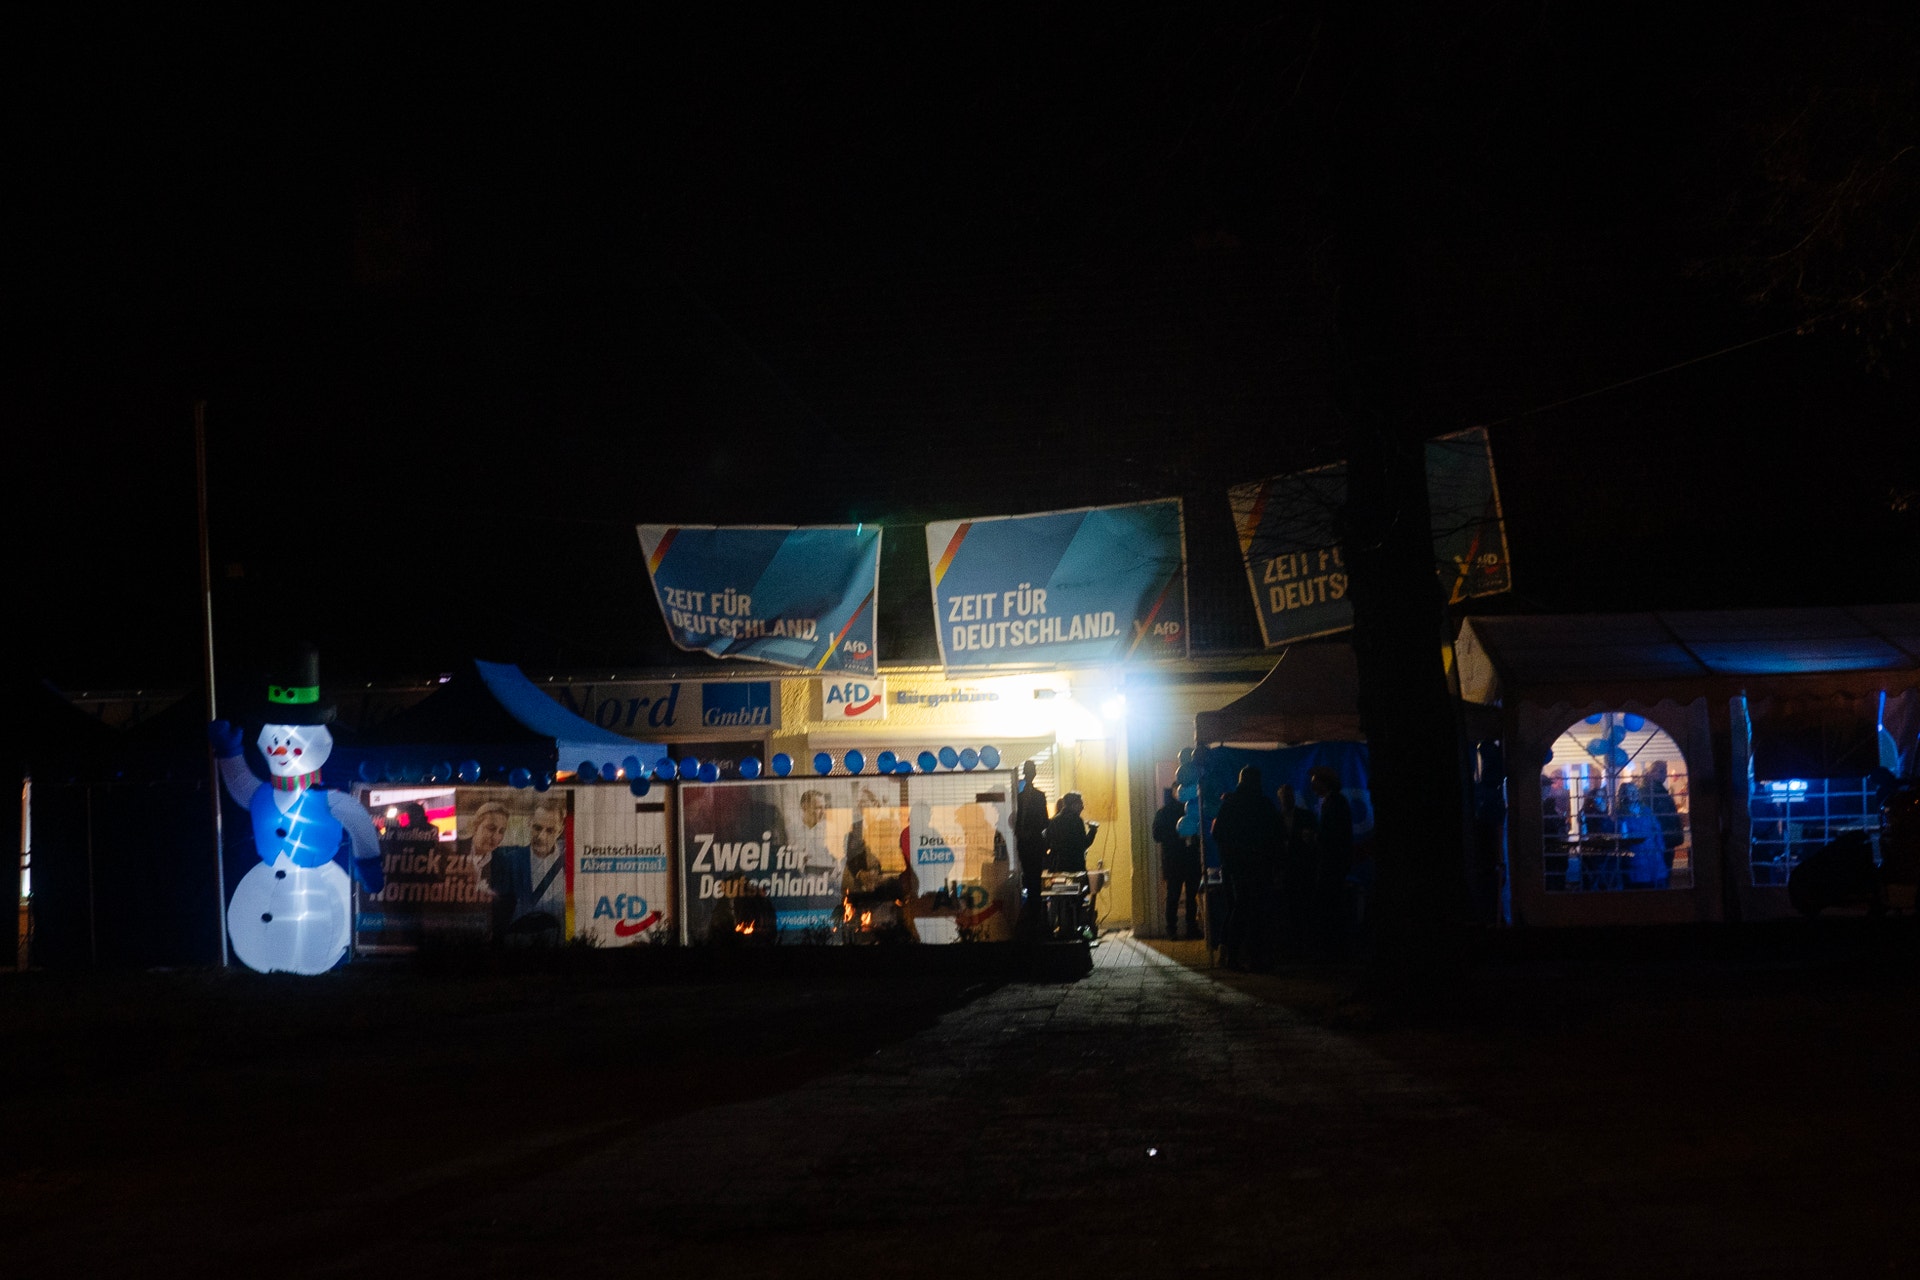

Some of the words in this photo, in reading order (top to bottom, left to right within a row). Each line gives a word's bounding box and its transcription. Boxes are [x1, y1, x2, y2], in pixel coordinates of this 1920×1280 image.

[664, 586, 705, 612] ZEIT
[711, 587, 752, 617] FÜR
[948, 592, 997, 622] ZEIT
[1003, 582, 1048, 618] FÜR
[672, 608, 819, 642] DEUTSCHLAND.
[953, 611, 1121, 651] DEUTSCHLAND.
[1154, 621, 1180, 635] AfD
[843, 640, 868, 653] AfD
[560, 683, 680, 729] Nord
[704, 706, 769, 726] GmbH
[826, 682, 870, 704] AfD
[382, 847, 440, 874] rück
[584, 844, 665, 856] Deutschland.
[691, 830, 772, 873] Zwei
[776, 844, 808, 873] für
[920, 848, 953, 862] Aber
[583, 858, 613, 871] Aber
[616, 857, 664, 871] normal.
[699, 871, 835, 899] Deutschland.
[593, 893, 648, 919] AfD
